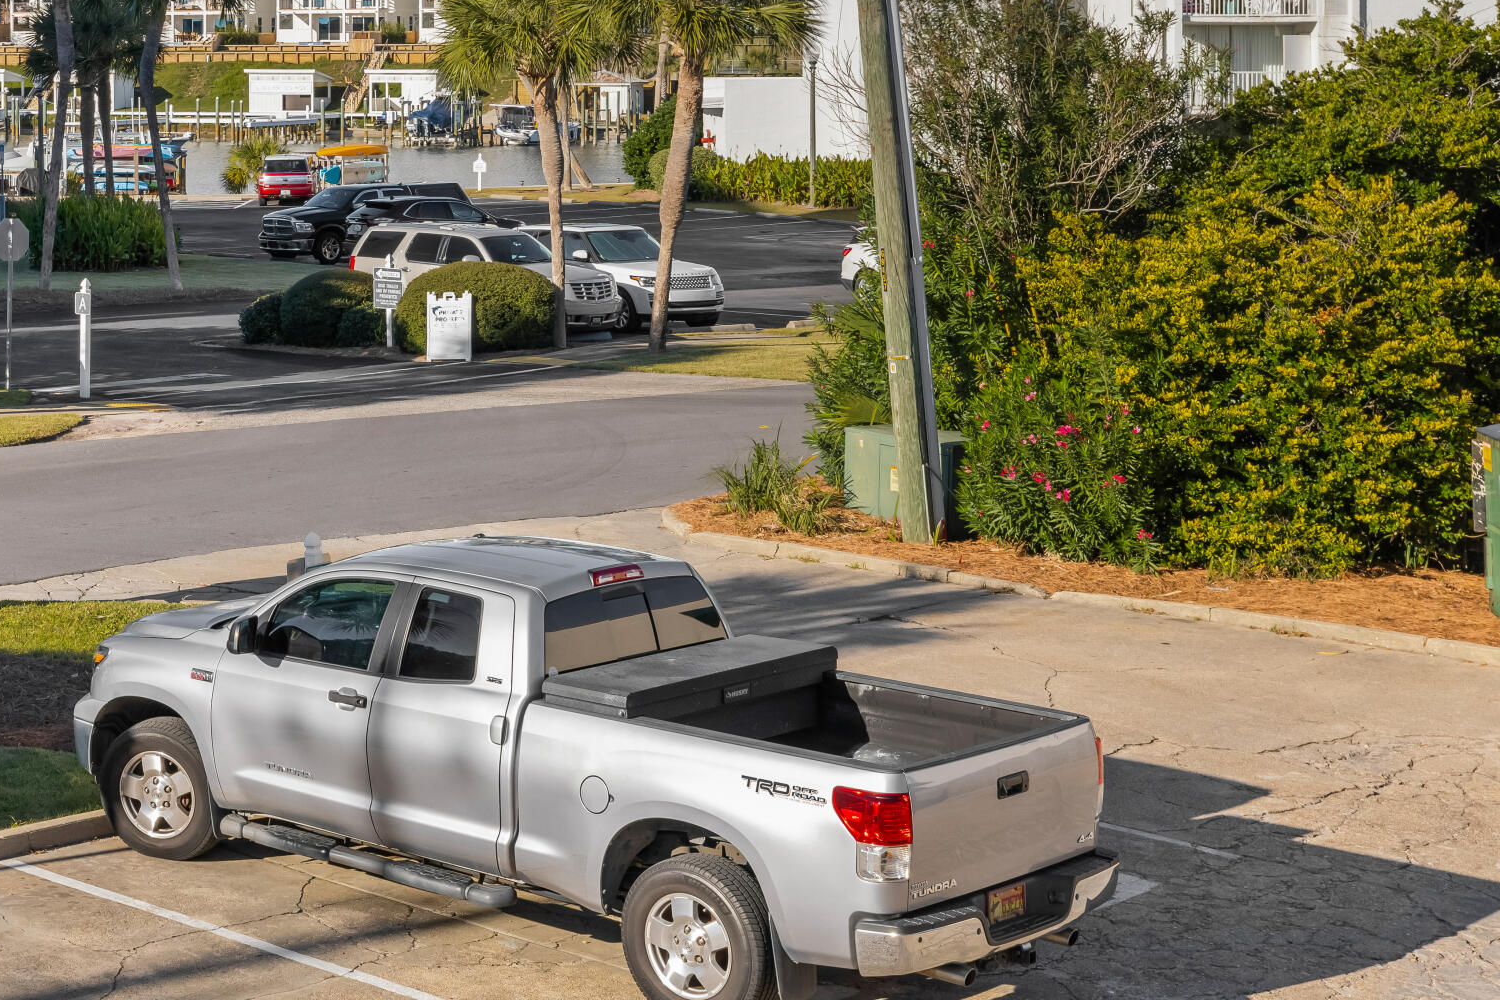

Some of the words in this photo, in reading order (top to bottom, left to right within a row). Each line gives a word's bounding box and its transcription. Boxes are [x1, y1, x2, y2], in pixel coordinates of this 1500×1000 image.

[78, 296, 87, 310] A
[741, 774, 790, 797] TRD
[792, 785, 819, 794] OFF
[791, 791, 828, 804] ROAD
[911, 878, 958, 899] TUNDRA
